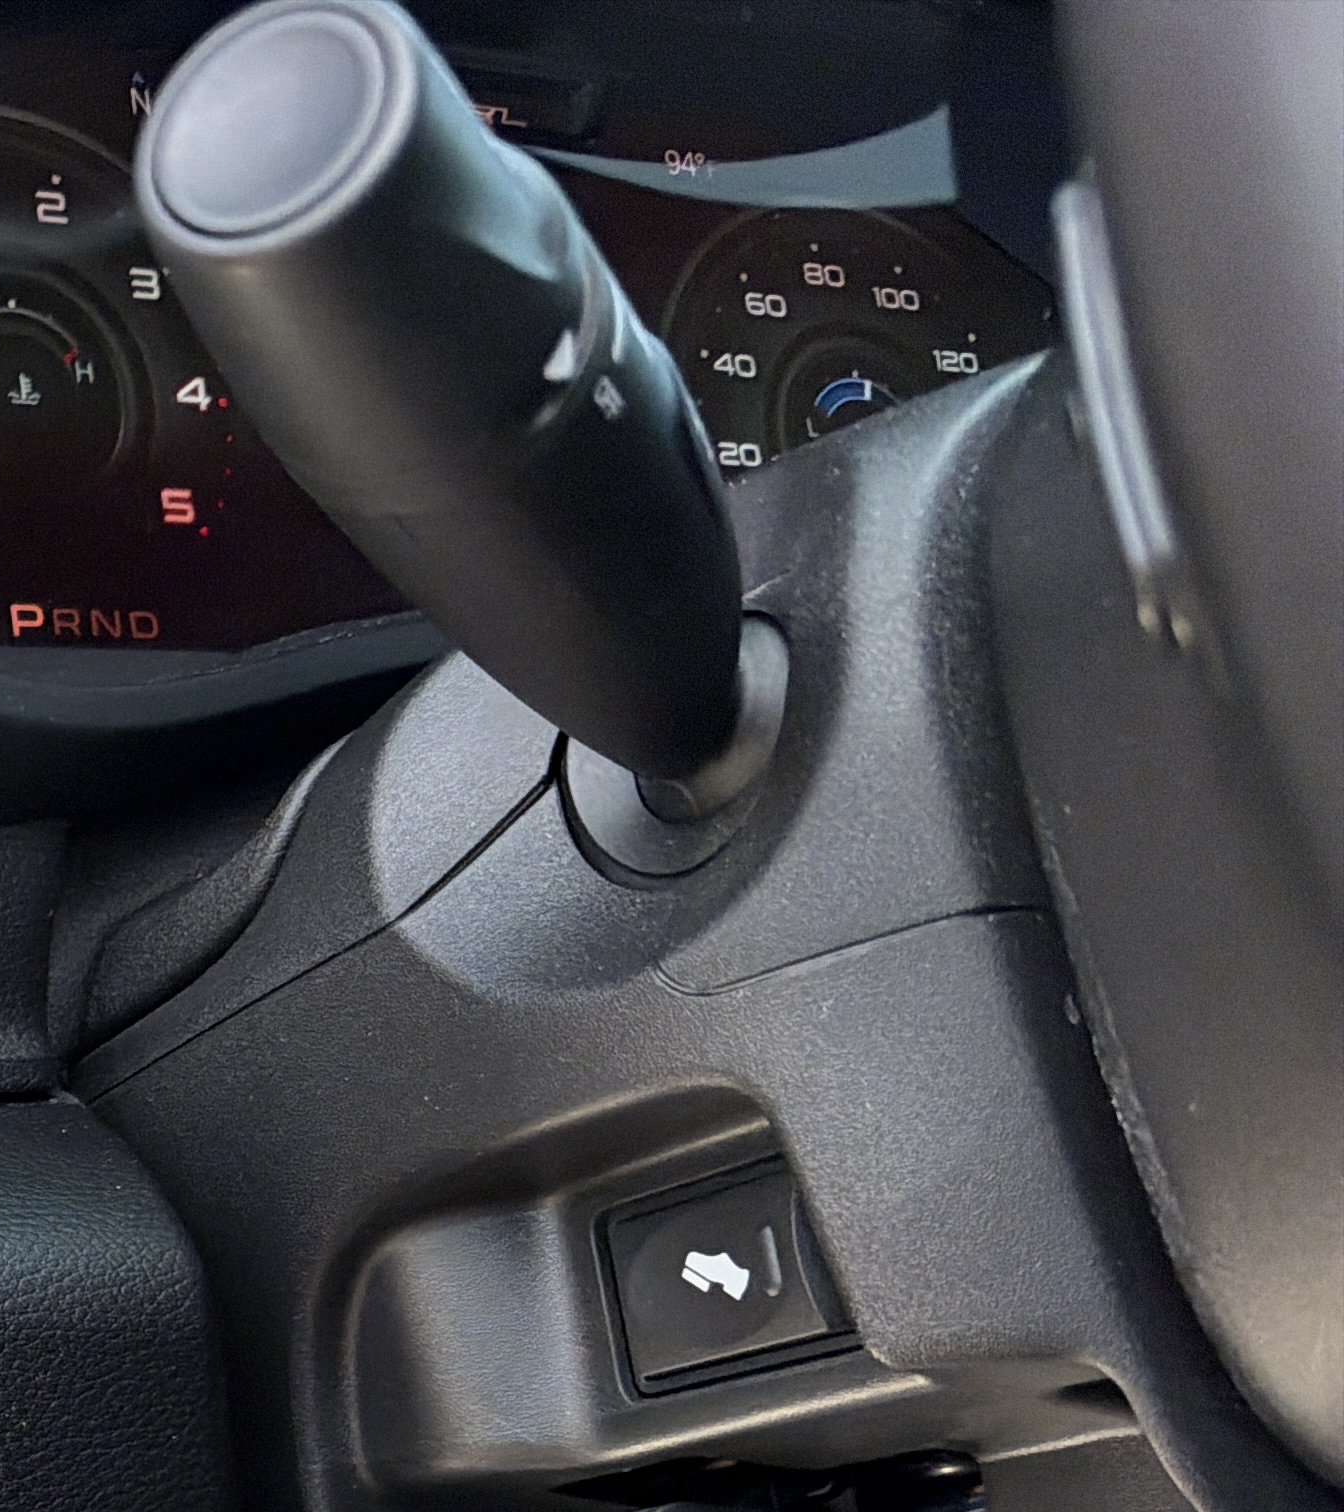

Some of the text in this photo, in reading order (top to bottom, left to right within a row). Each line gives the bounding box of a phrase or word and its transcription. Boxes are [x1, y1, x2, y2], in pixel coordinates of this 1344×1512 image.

[129, 87, 152, 115] N
[35, 191, 68, 224] 2
[129, 267, 161, 300] 3
[803, 263, 845, 288] 80
[745, 293, 787, 318] 60
[872, 287, 920, 312] 100
[75, 361, 94, 383] H
[713, 354, 756, 378] 40
[932, 349, 978, 374] 120
[176, 376, 211, 410] 4
[718, 443, 762, 468] 20
[160, 488, 195, 525] 5
